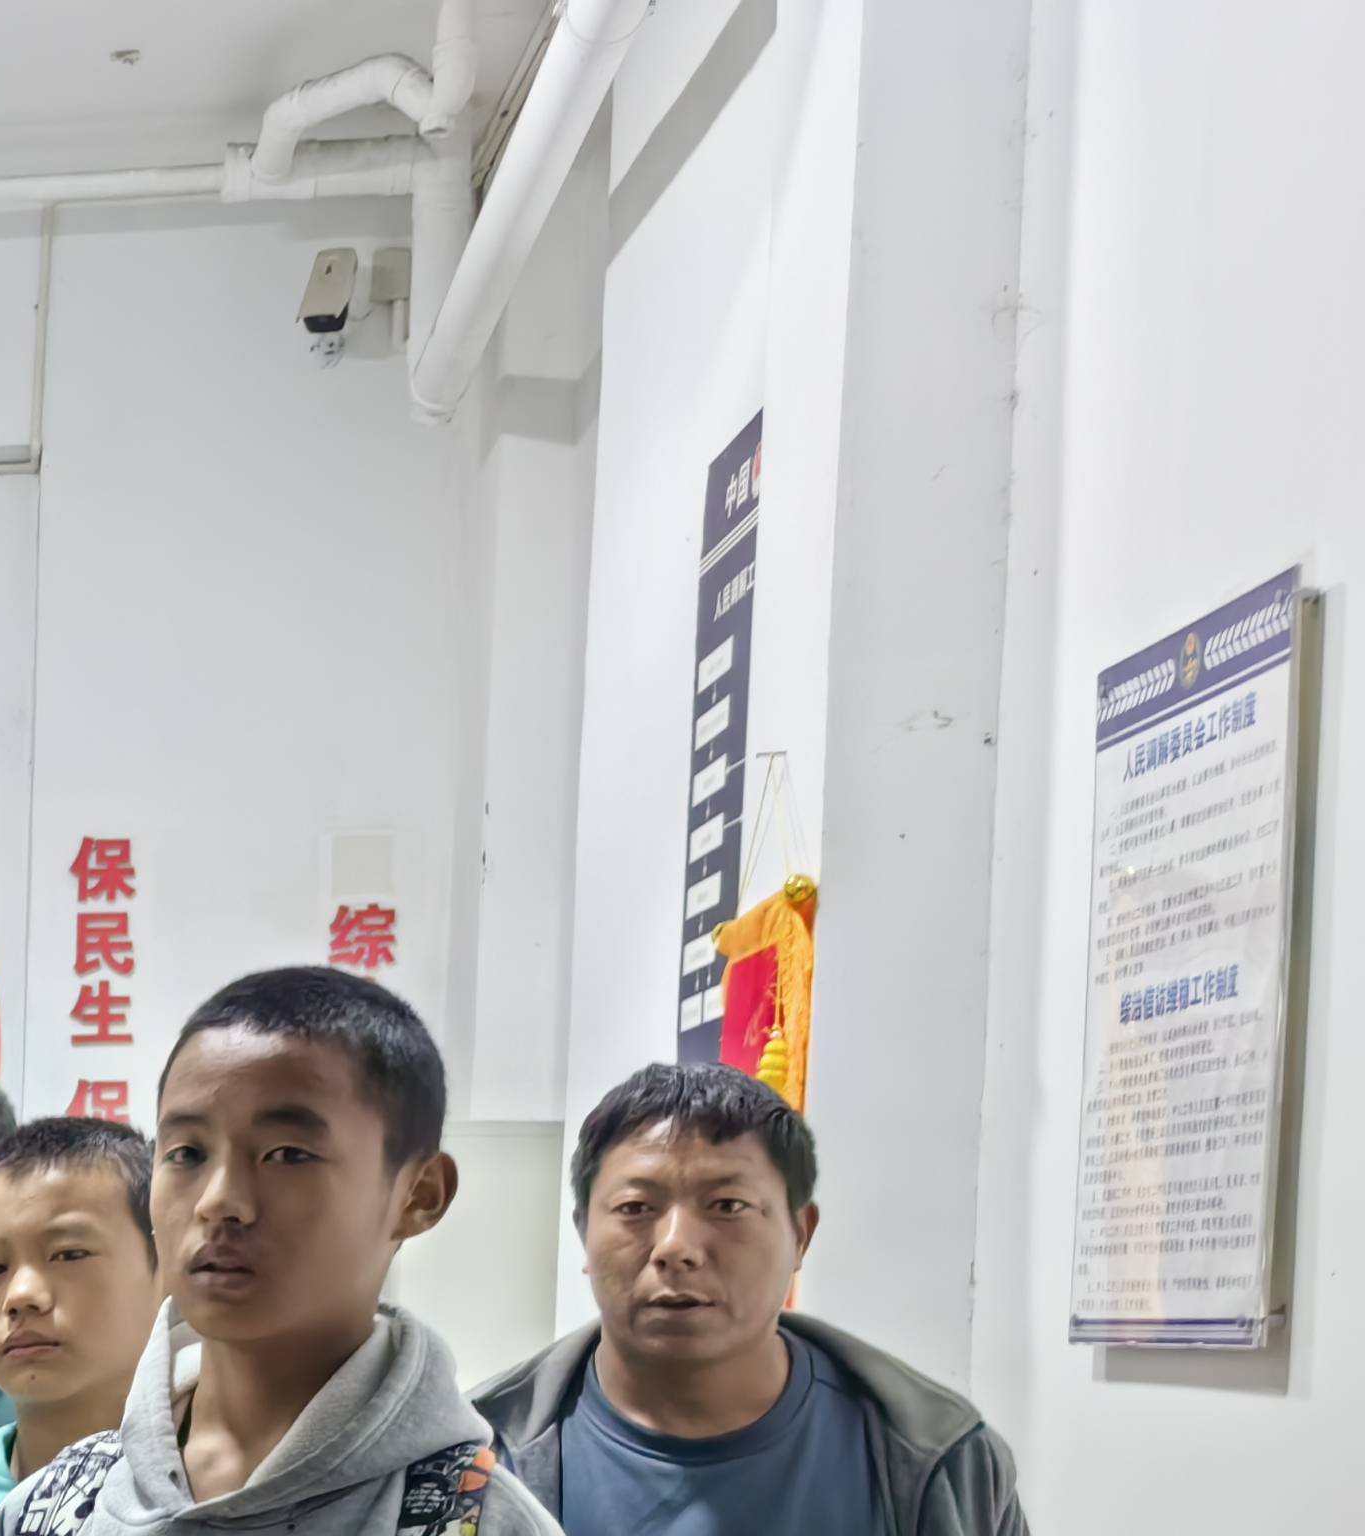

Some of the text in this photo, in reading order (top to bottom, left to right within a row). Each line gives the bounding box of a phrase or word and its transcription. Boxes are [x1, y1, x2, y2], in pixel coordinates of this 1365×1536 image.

[1122, 691, 1257, 784] 人民调解委员会工作制度
[70, 836, 137, 1048] 保民生
